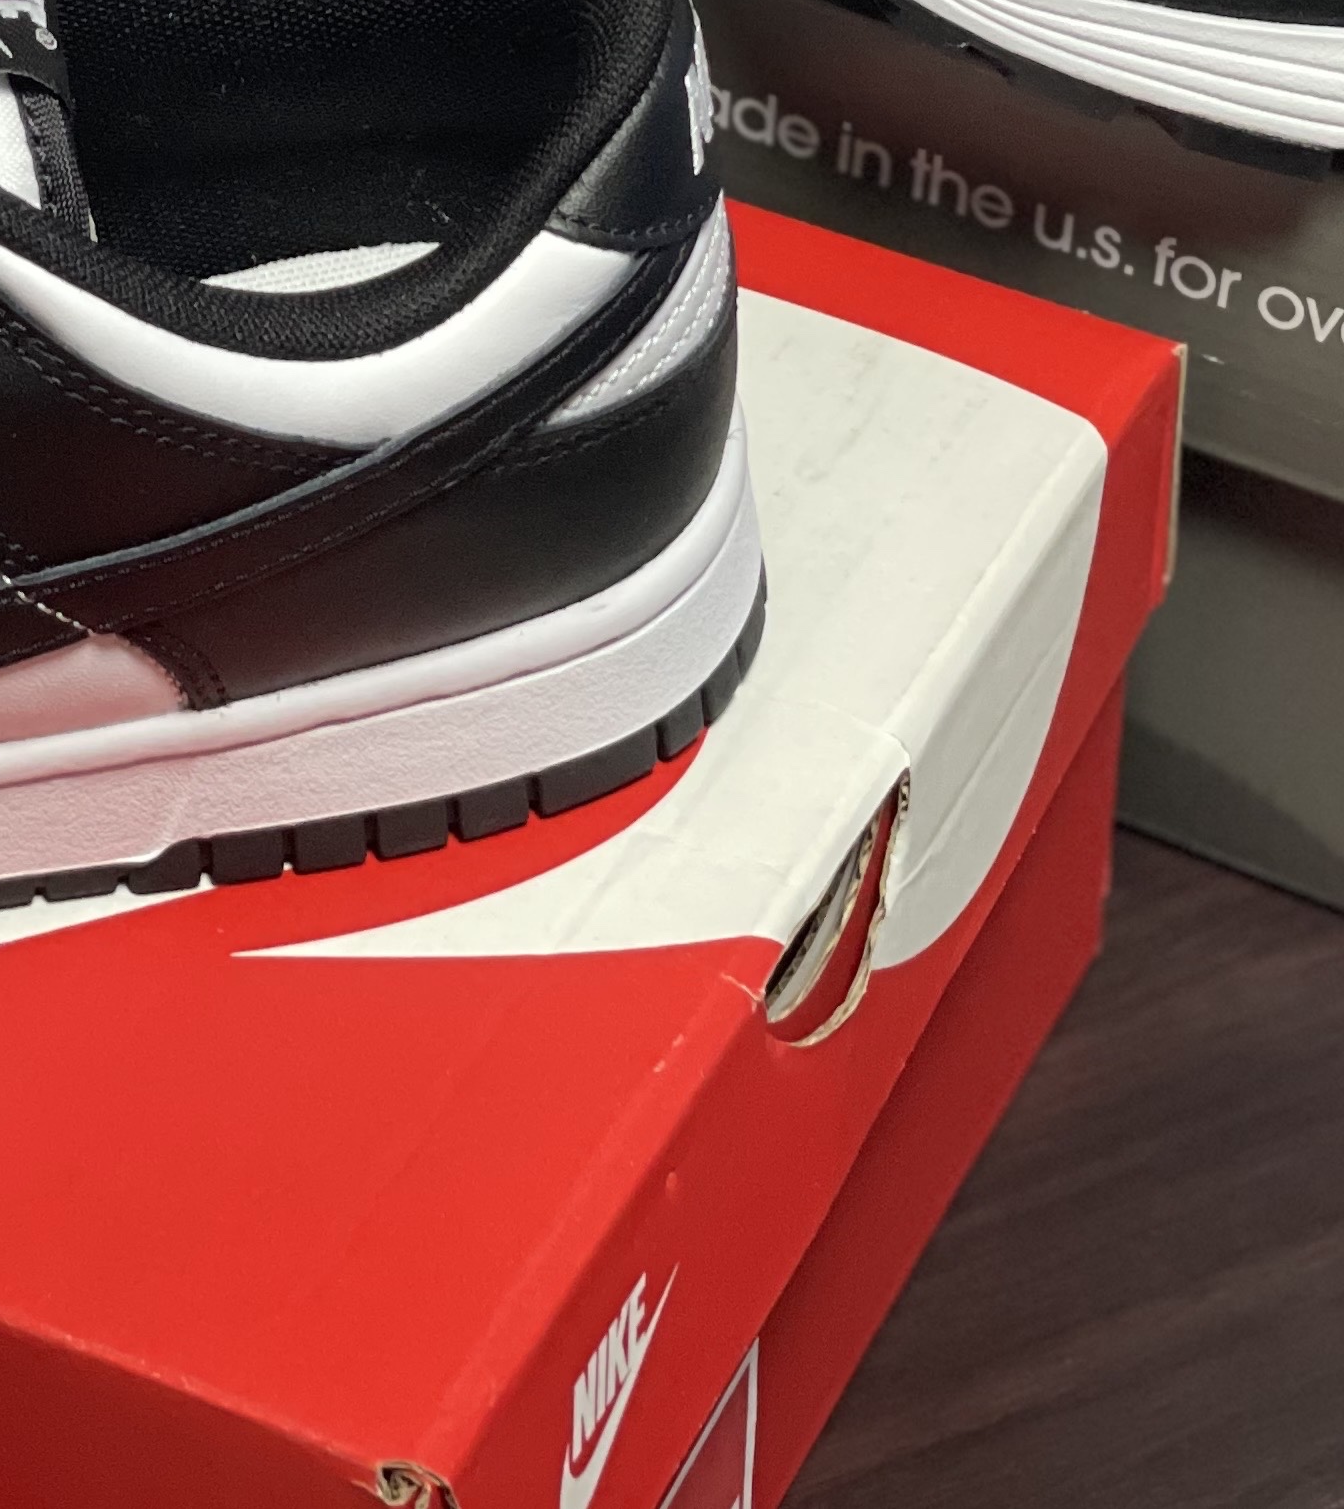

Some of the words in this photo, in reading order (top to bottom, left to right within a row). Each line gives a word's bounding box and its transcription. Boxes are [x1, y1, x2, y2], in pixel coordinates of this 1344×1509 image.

[836, 121, 894, 188] in
[902, 146, 1016, 231] the
[1032, 203, 1136, 278] u.s.
[1153, 236, 1244, 310] for
[571, 1271, 648, 1463] NIKE
